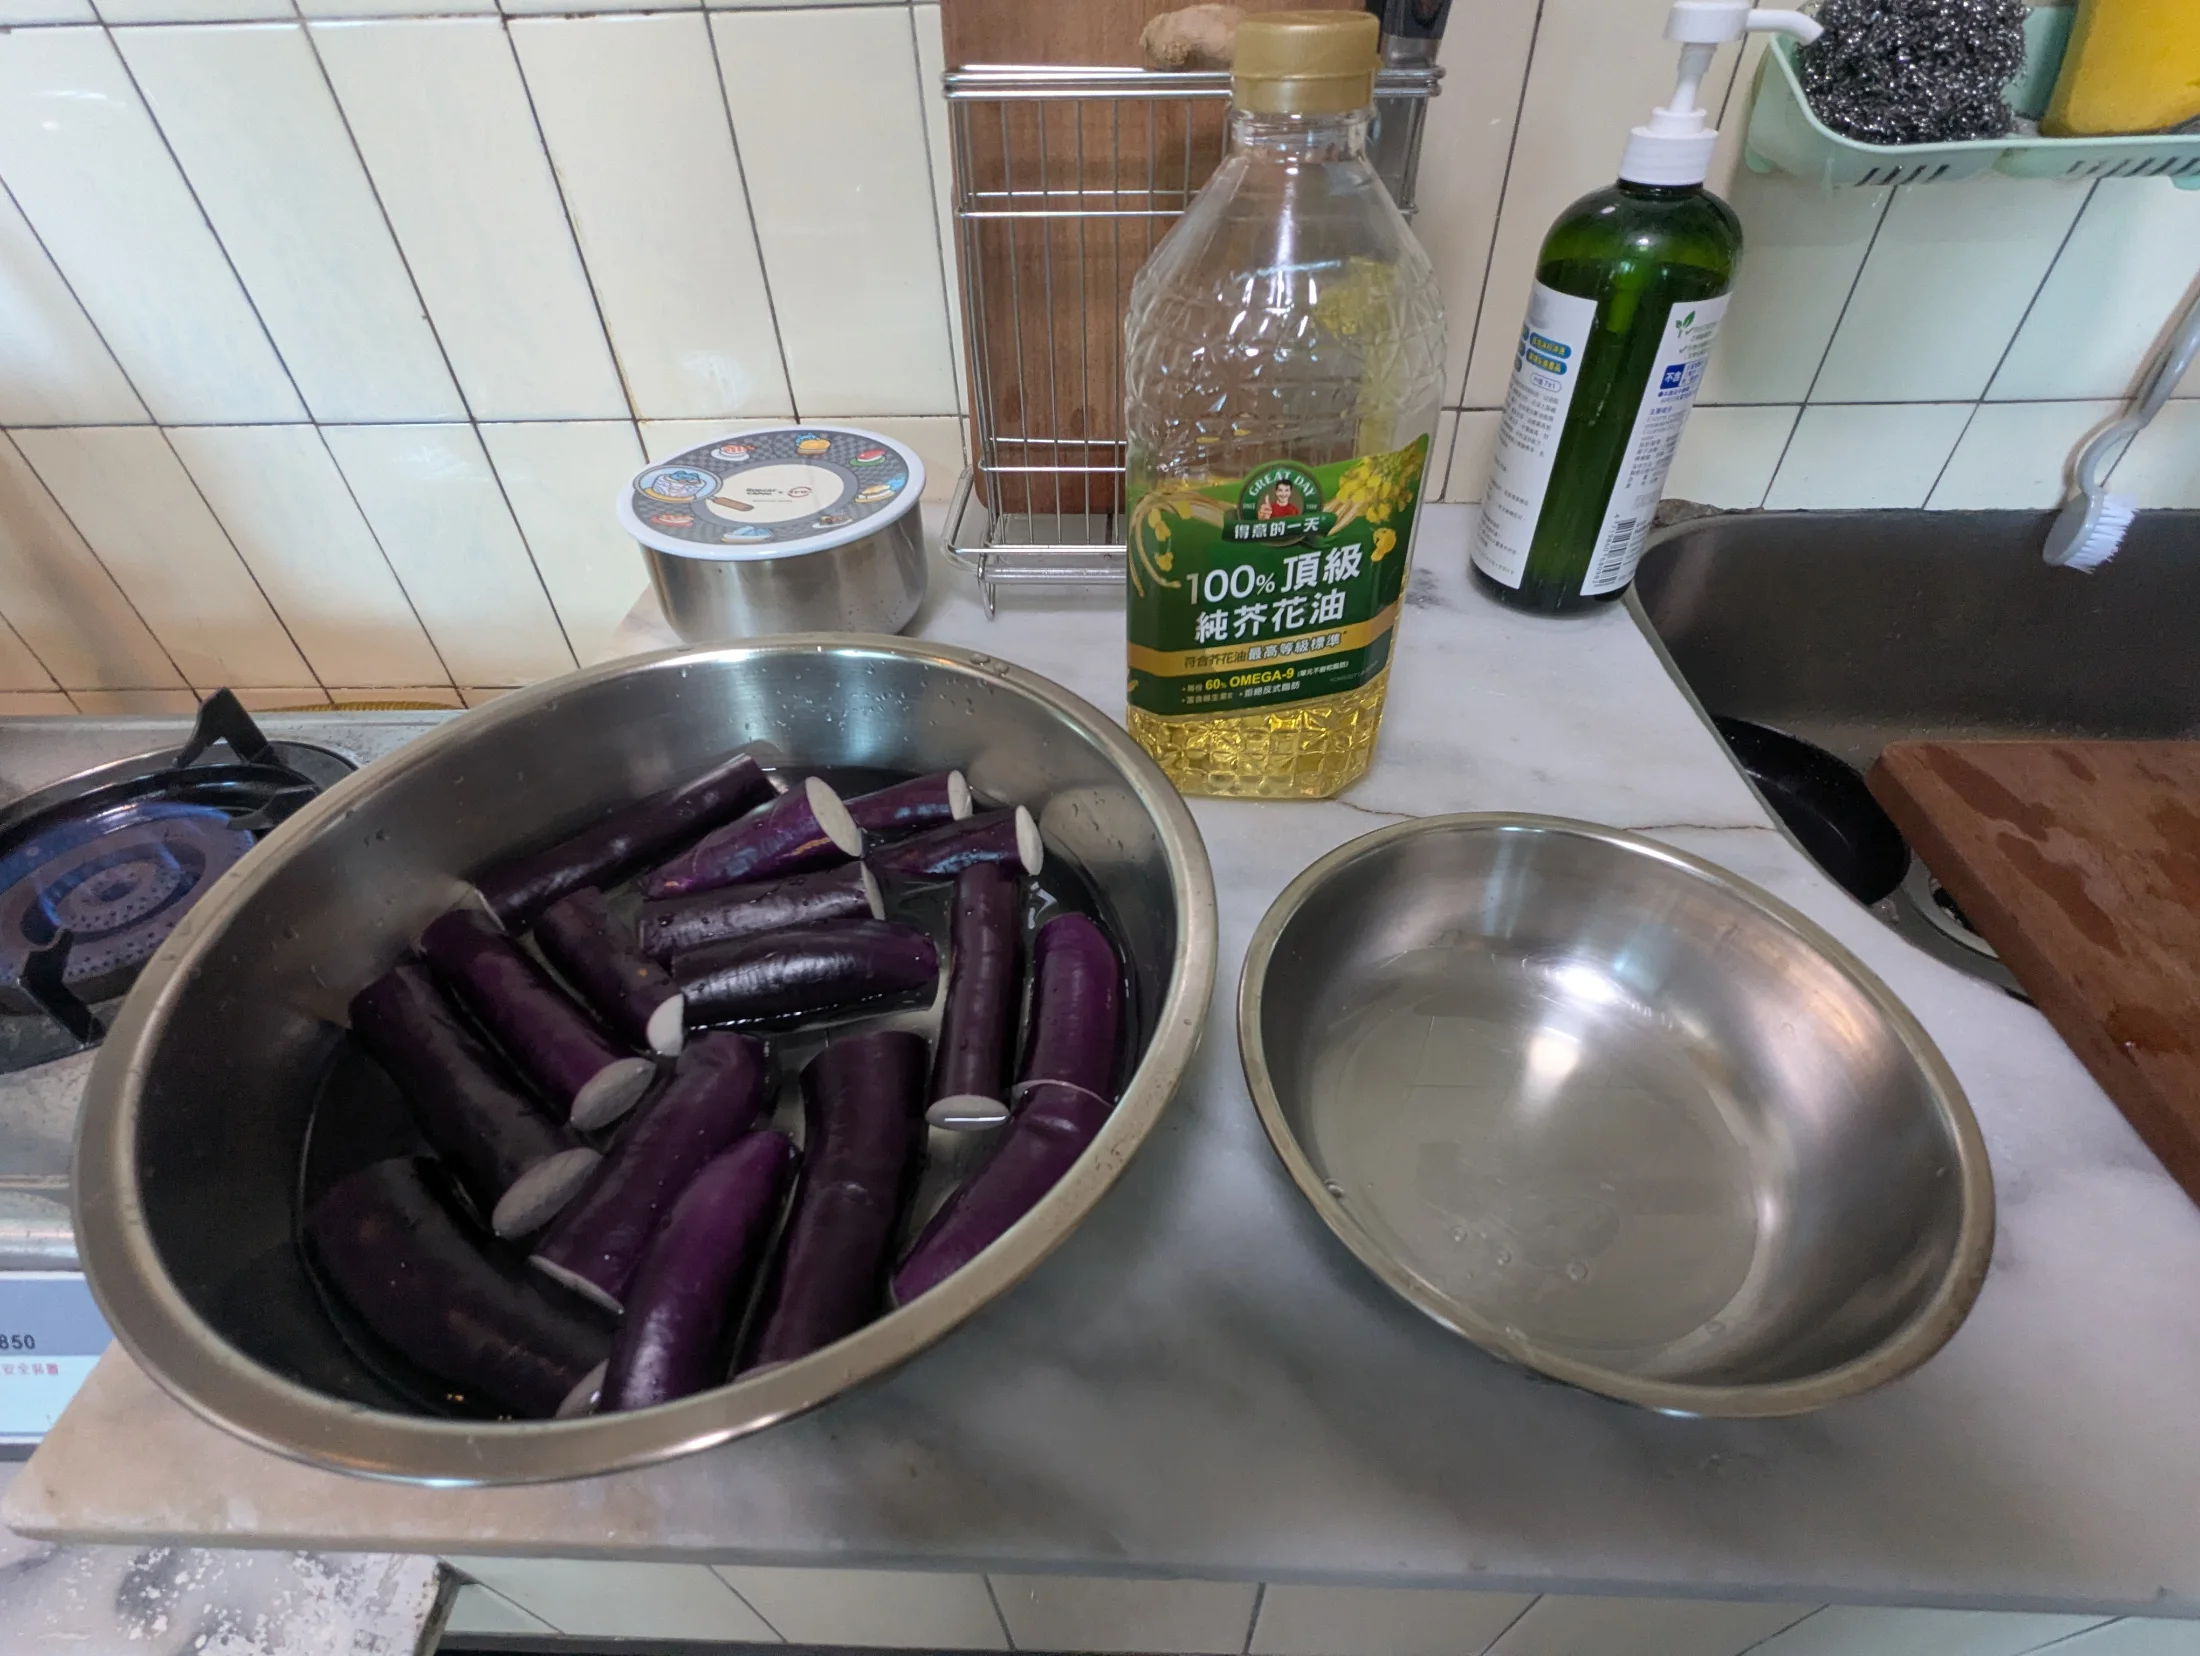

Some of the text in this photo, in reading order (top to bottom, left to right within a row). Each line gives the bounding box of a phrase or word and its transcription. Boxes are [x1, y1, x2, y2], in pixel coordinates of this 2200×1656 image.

[1664, 370, 1682, 383] 不含
[1249, 471, 1317, 498] GREAT DAY
[1234, 516, 1321, 540] 得意的一天
[1187, 543, 1363, 605] 100% 頂級
[1194, 588, 1347, 645] 純芥花油
[1205, 678, 1228, 691] 60%
[1229, 667, 1295, 688] OMEGA-9
